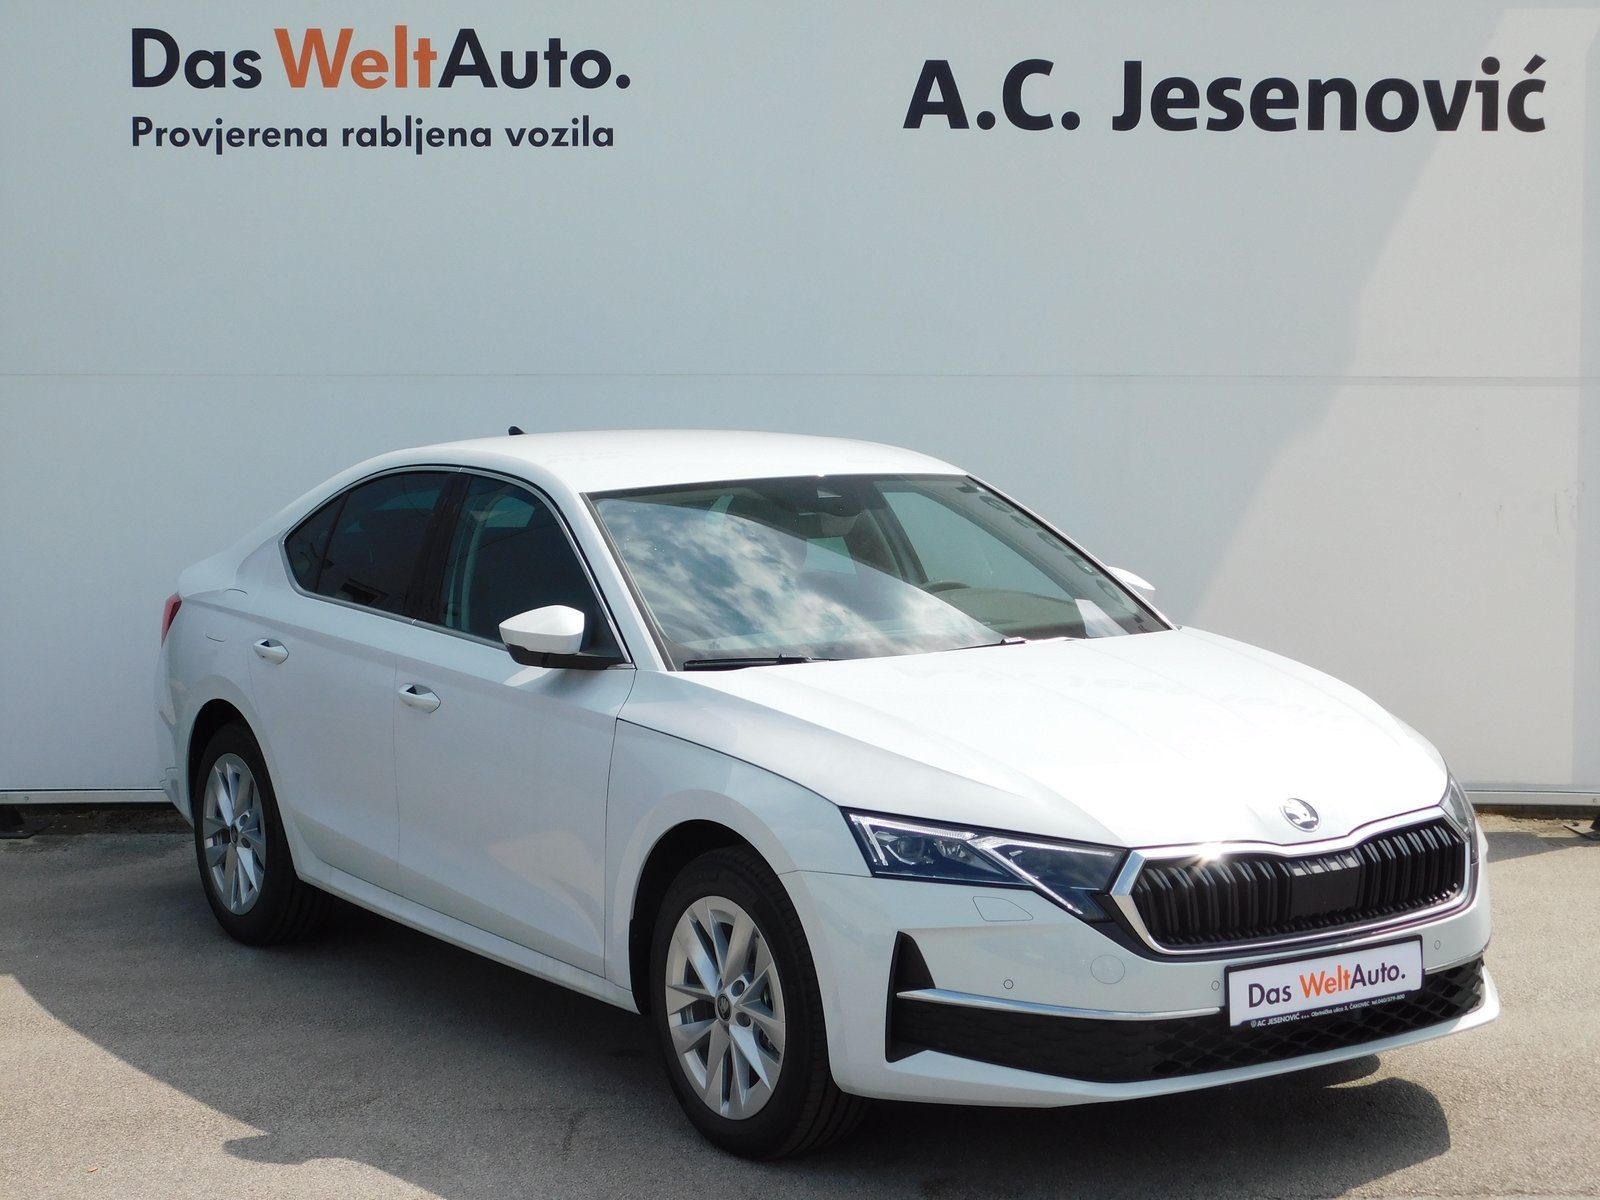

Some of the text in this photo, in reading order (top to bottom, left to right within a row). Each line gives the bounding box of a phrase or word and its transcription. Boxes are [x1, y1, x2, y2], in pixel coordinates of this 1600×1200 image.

[131, 25, 631, 90] Das WeltAuto.
[902, 54, 1547, 133] A.C. Jesenović
[131, 115, 615, 155] Provjerena rabljena vozila
[1248, 962, 1406, 1008] Das WeltAuto.
[1257, 1019, 1266, 1027] AC
[1267, 1012, 1300, 1026] JESENOVIĆ
